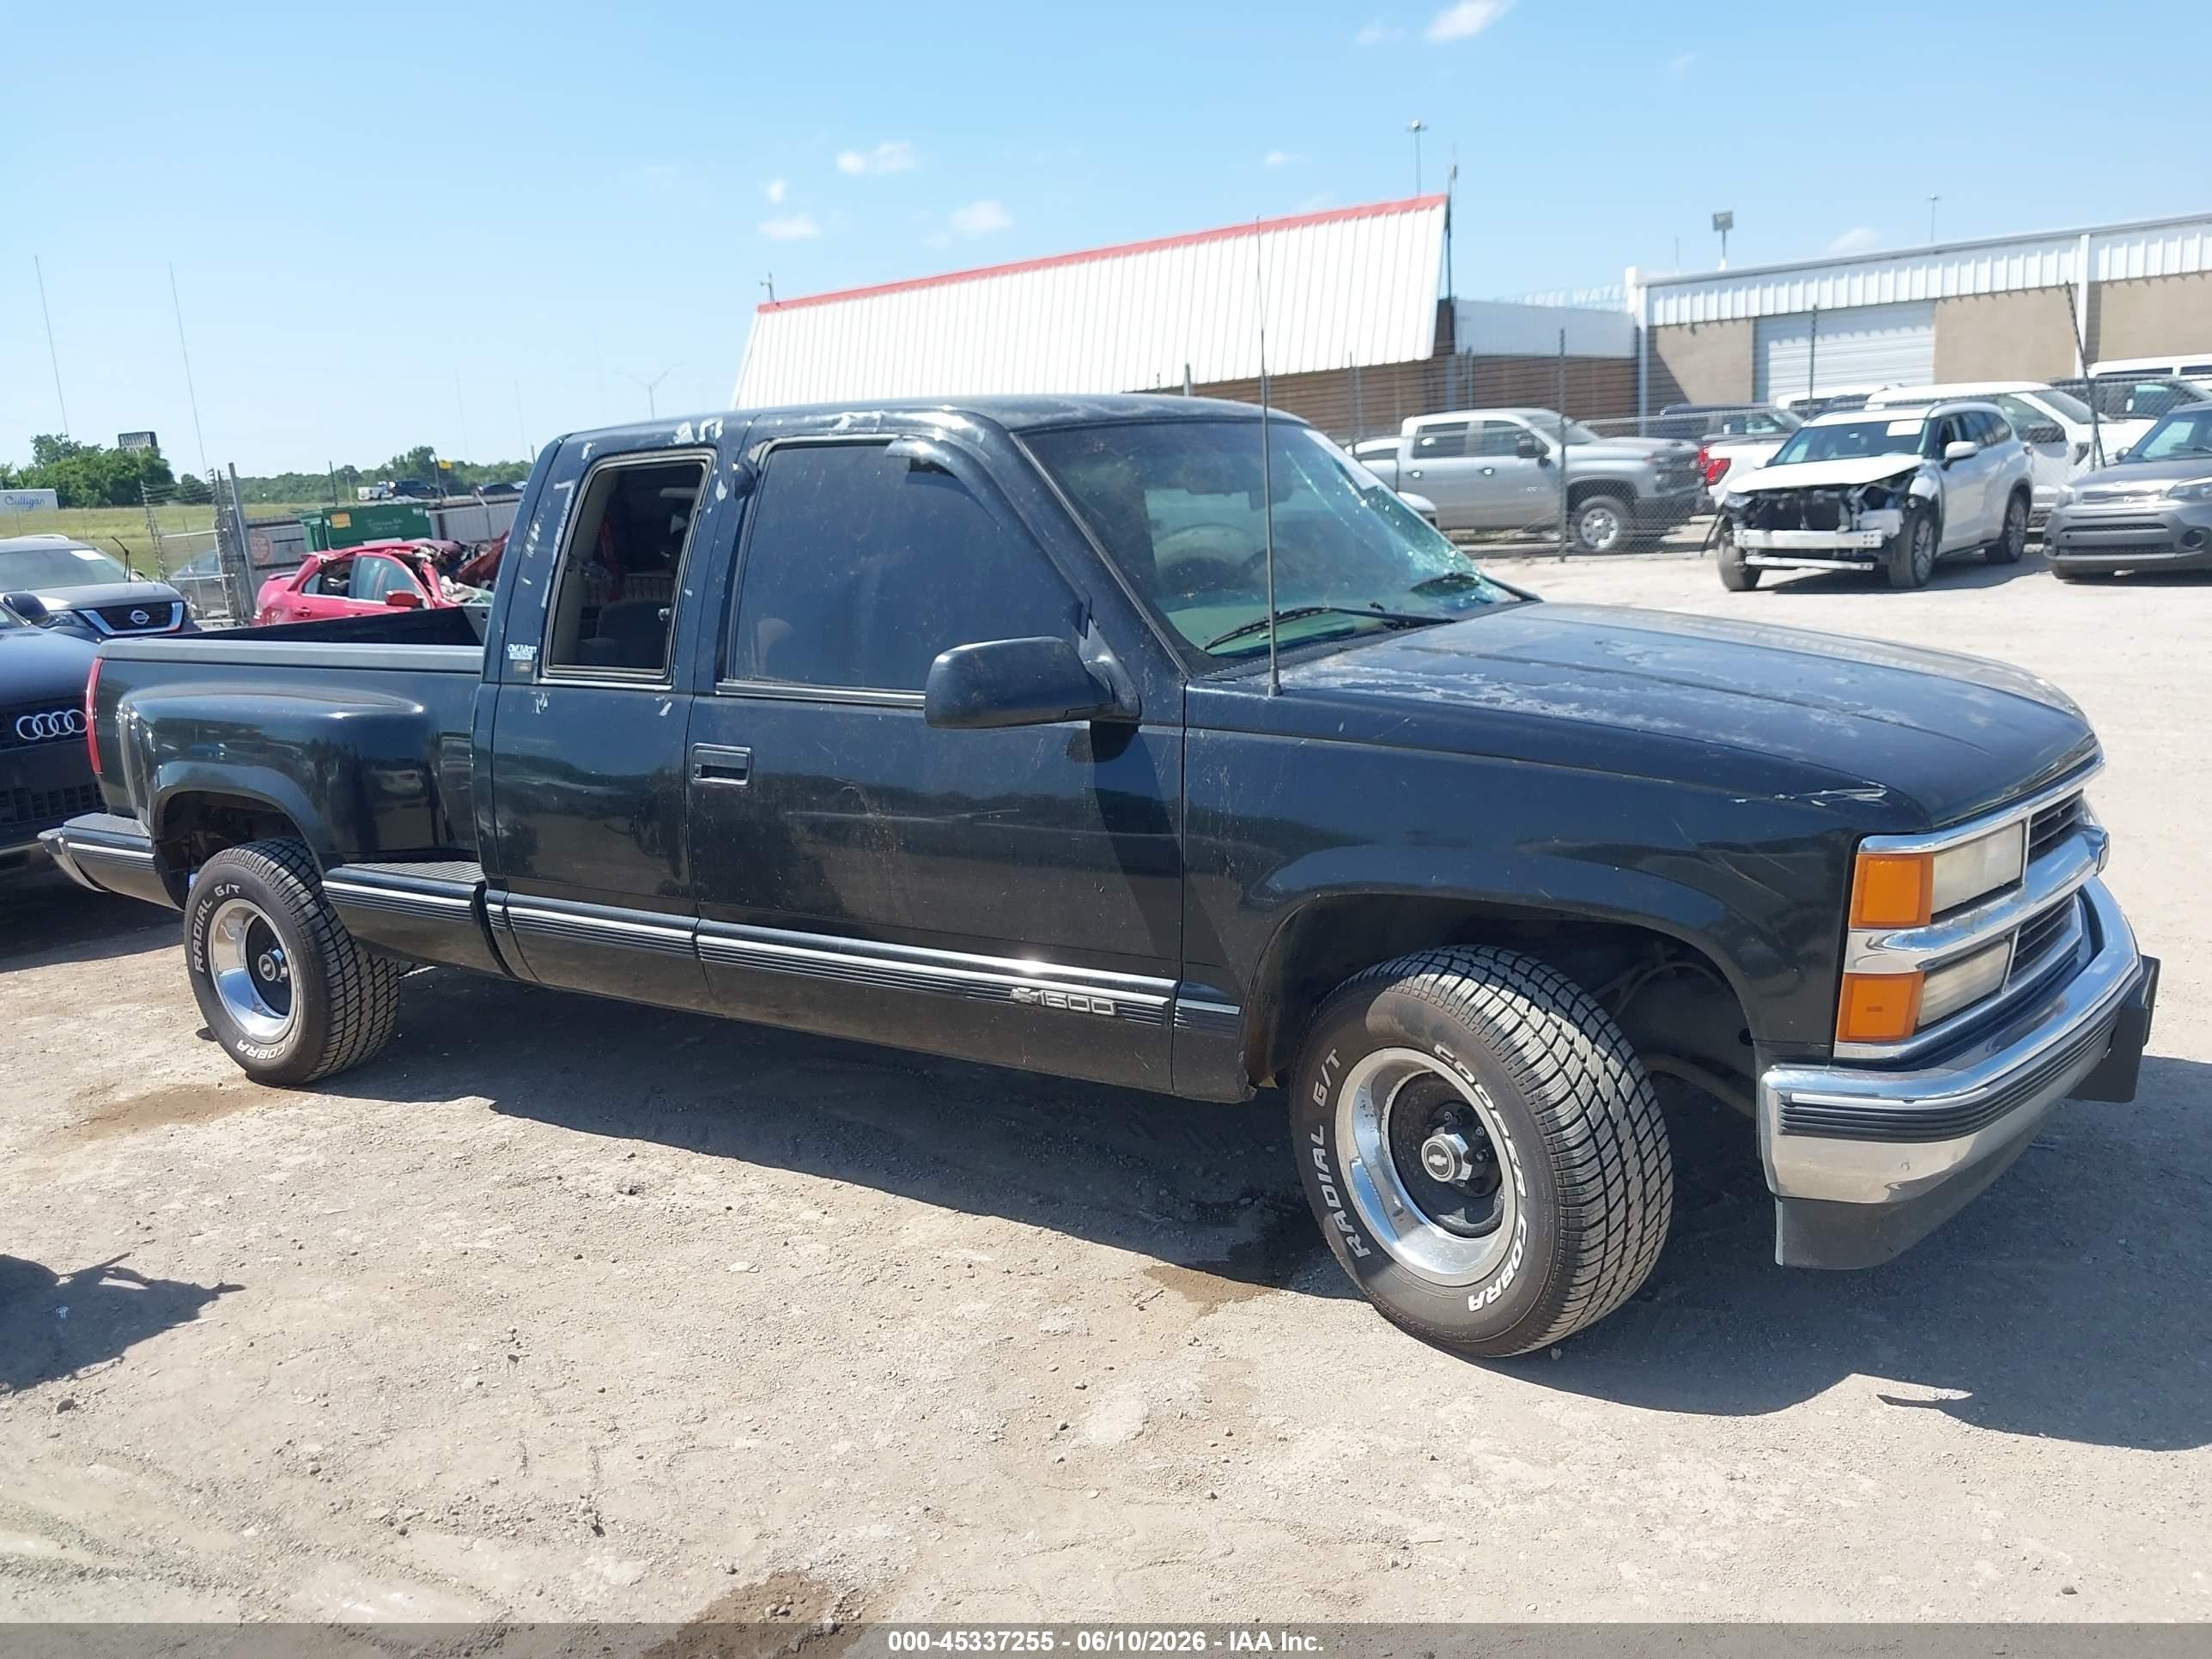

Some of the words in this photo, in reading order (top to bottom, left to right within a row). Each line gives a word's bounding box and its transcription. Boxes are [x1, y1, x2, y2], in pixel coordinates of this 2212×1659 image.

[4, 495, 45, 508] Culligan
[193, 898, 213, 973] RADIAL
[215, 884, 240, 896] G/T
[236, 1041, 286, 1060] COBRA
[1312, 1048, 1340, 1107] G/T
[1434, 1043, 1528, 1198] COOPER
[1310, 1124, 1371, 1258] RADIAL
[1468, 1213, 1528, 1312] COBRA
